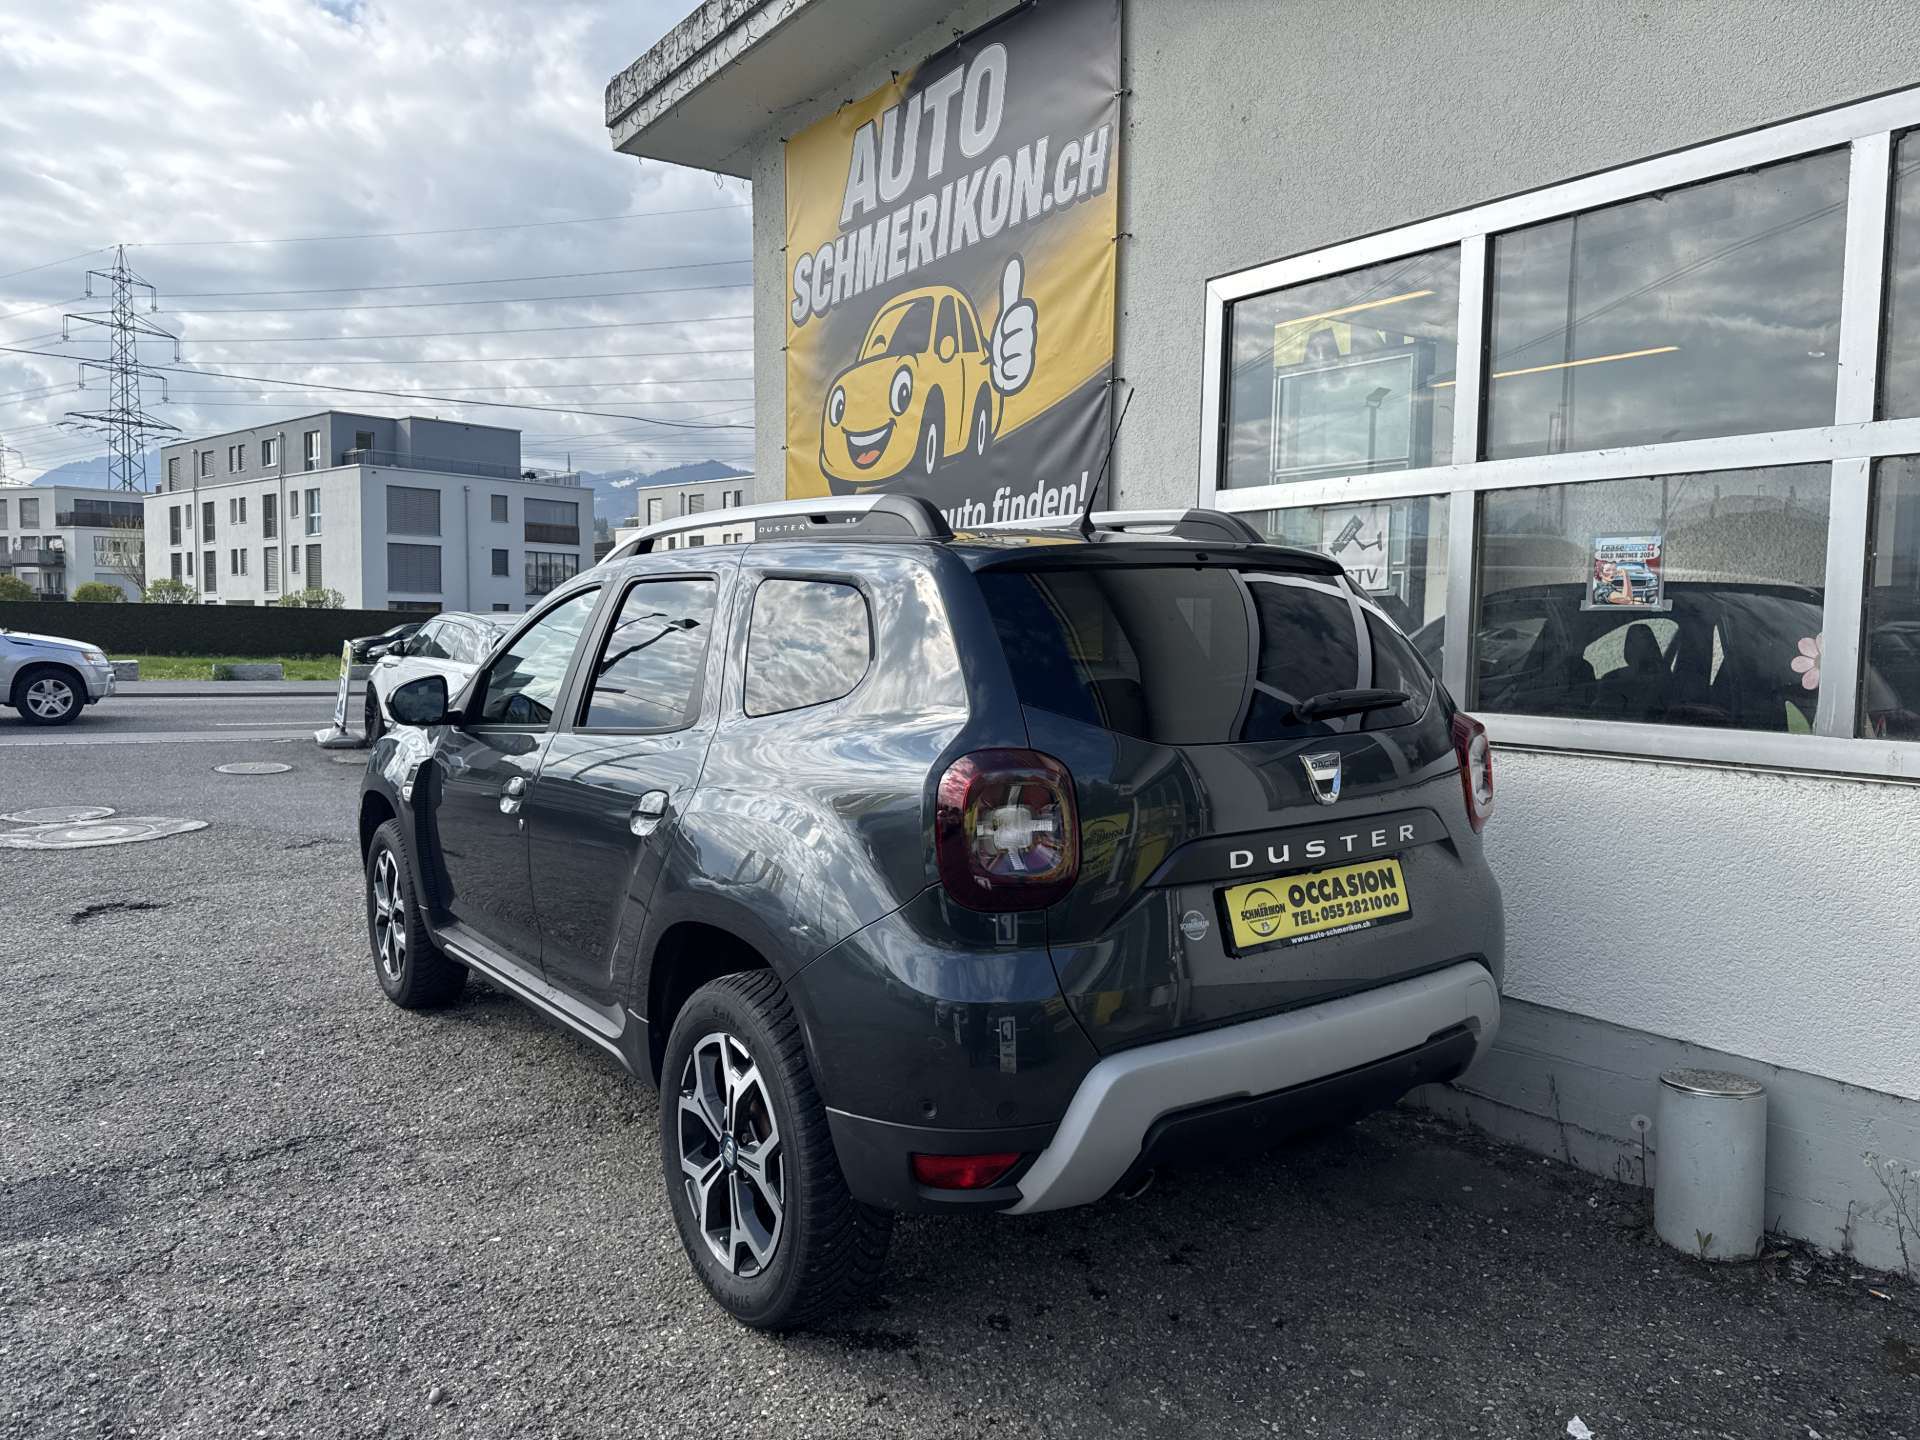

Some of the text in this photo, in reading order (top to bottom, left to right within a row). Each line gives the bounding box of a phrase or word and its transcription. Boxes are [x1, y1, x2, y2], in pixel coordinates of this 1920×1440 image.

[840, 43, 1007, 226] AUTO
[792, 124, 1110, 322] SCHMERIKON.CH
[993, 471, 1088, 522] finden!
[759, 524, 805, 533] DUSTER
[1229, 824, 1415, 870] DUSTER
[1288, 867, 1397, 908] OCCASION
[1241, 903, 1286, 921] SCHMERIKON
[1291, 921, 1371, 944] www.auto-schmerikon.ch
[1292, 909, 1320, 927] TEL:
[1321, 903, 1345, 921] 055
